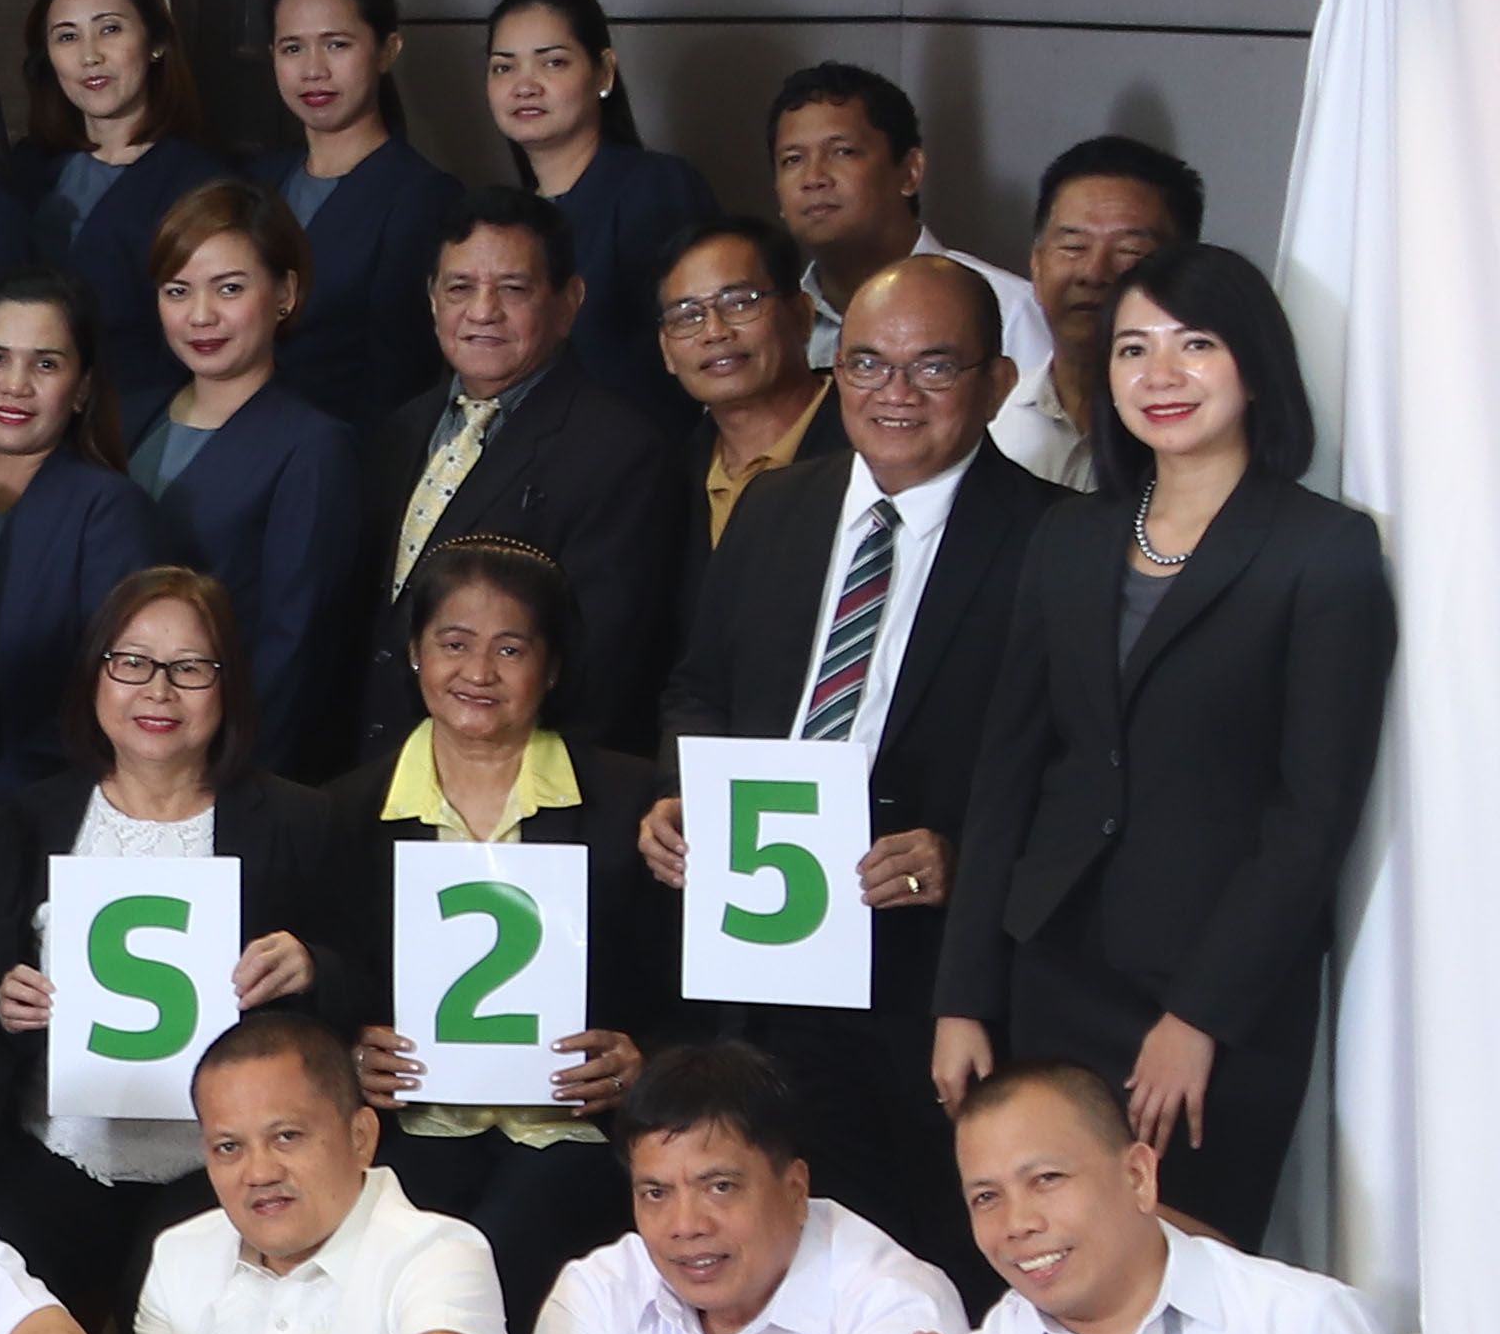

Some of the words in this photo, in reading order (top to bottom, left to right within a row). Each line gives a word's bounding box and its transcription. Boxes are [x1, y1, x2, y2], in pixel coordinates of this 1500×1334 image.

[721, 779, 829, 944] 5
[87, 895, 197, 1060] S
[437, 881, 542, 1044] 2
